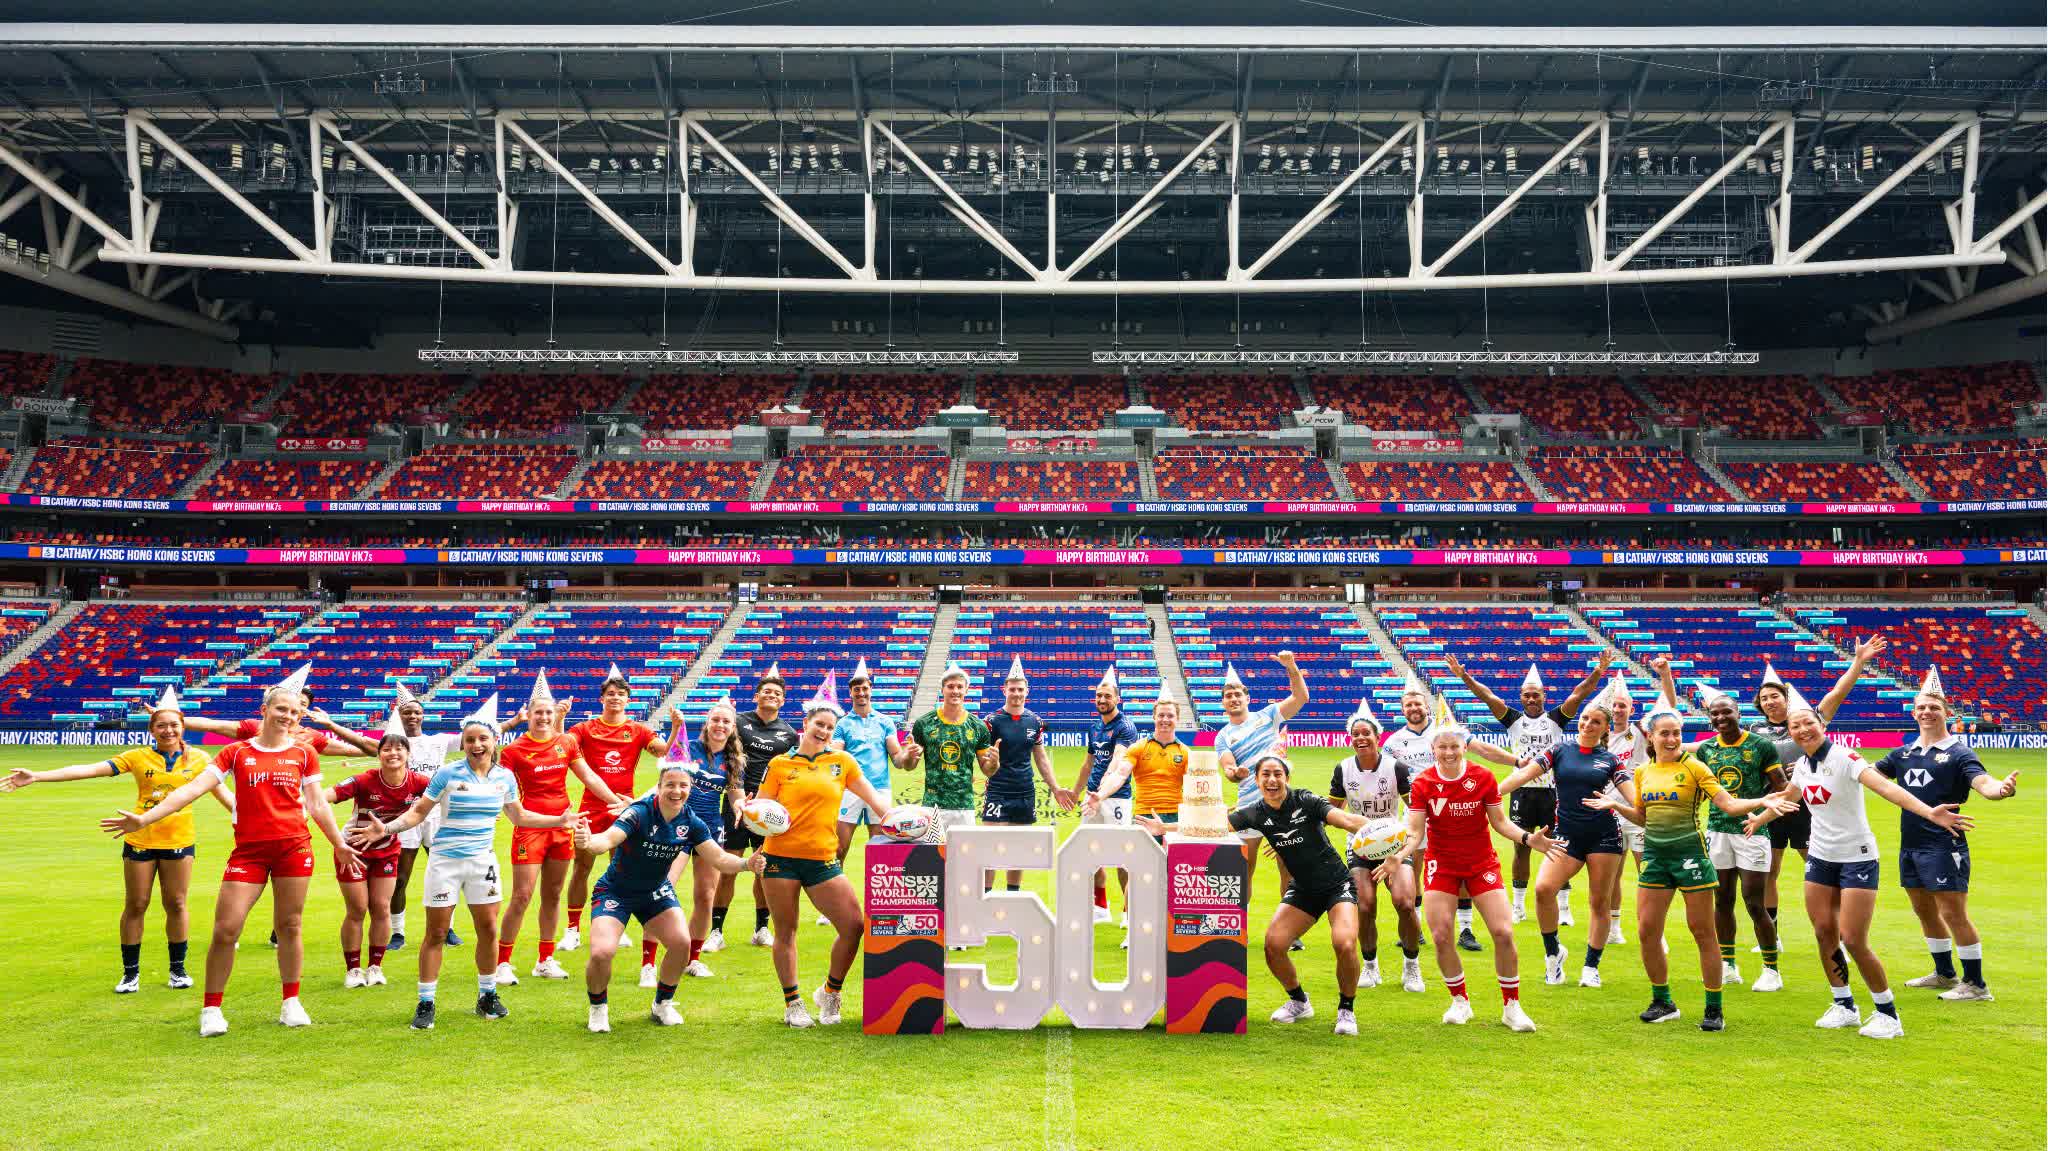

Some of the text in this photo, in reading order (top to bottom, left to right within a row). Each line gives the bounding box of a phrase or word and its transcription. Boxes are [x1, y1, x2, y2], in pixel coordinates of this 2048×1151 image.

[57, 548, 215, 561] CATHAY/HSBC HONG KONG SEVENS
[280, 551, 372, 561] HAPPY BIRTHDAY HK7s
[461, 551, 603, 561] CATHAY/HSBC HONG KONG SEVENS
[669, 552, 760, 562] HAPPY BIRTHDAY HK7s
[849, 552, 991, 562] CATHAY/HSBC HONG KONG SEVENS
[1057, 552, 1148, 562] HAPPY BIRTHDAY HK7s
[1237, 552, 1380, 562] CATHAY/HSBC HONG KONG SEVENS
[1445, 553, 1537, 562] HAPPY BIRTHDAY HK7s
[1626, 553, 1768, 563] CATHAY/HSBC HONG KONG SEVENS
[1833, 553, 1927, 563] HAPPY BIRTHDAY HK7s
[0, 732, 156, 745] HAY/HSBC HONG KONG SEVE
[1052, 732, 1082, 746] HONG
[1287, 734, 1330, 746] RTHDAY
[1970, 735, 2047, 748] CATHAY/HSBC
[751, 742, 774, 752] ALTRAD
[1196, 781, 1210, 794] 50
[986, 803, 1002, 818] 24
[1448, 801, 1480, 810] VELOCIT
[1512, 800, 1519, 811] 3
[1114, 806, 1123, 820] 6
[1276, 836, 1304, 847] ALTRAD
[485, 865, 497, 883] 4
[871, 876, 917, 888] SVNS
[1174, 875, 1220, 887] SVNS
[872, 889, 916, 898] WORLD
[1174, 888, 1220, 897] WORLD
[915, 916, 936, 928] 50
[944, 824, 1167, 1030] 50
[1218, 916, 1240, 928] 50
